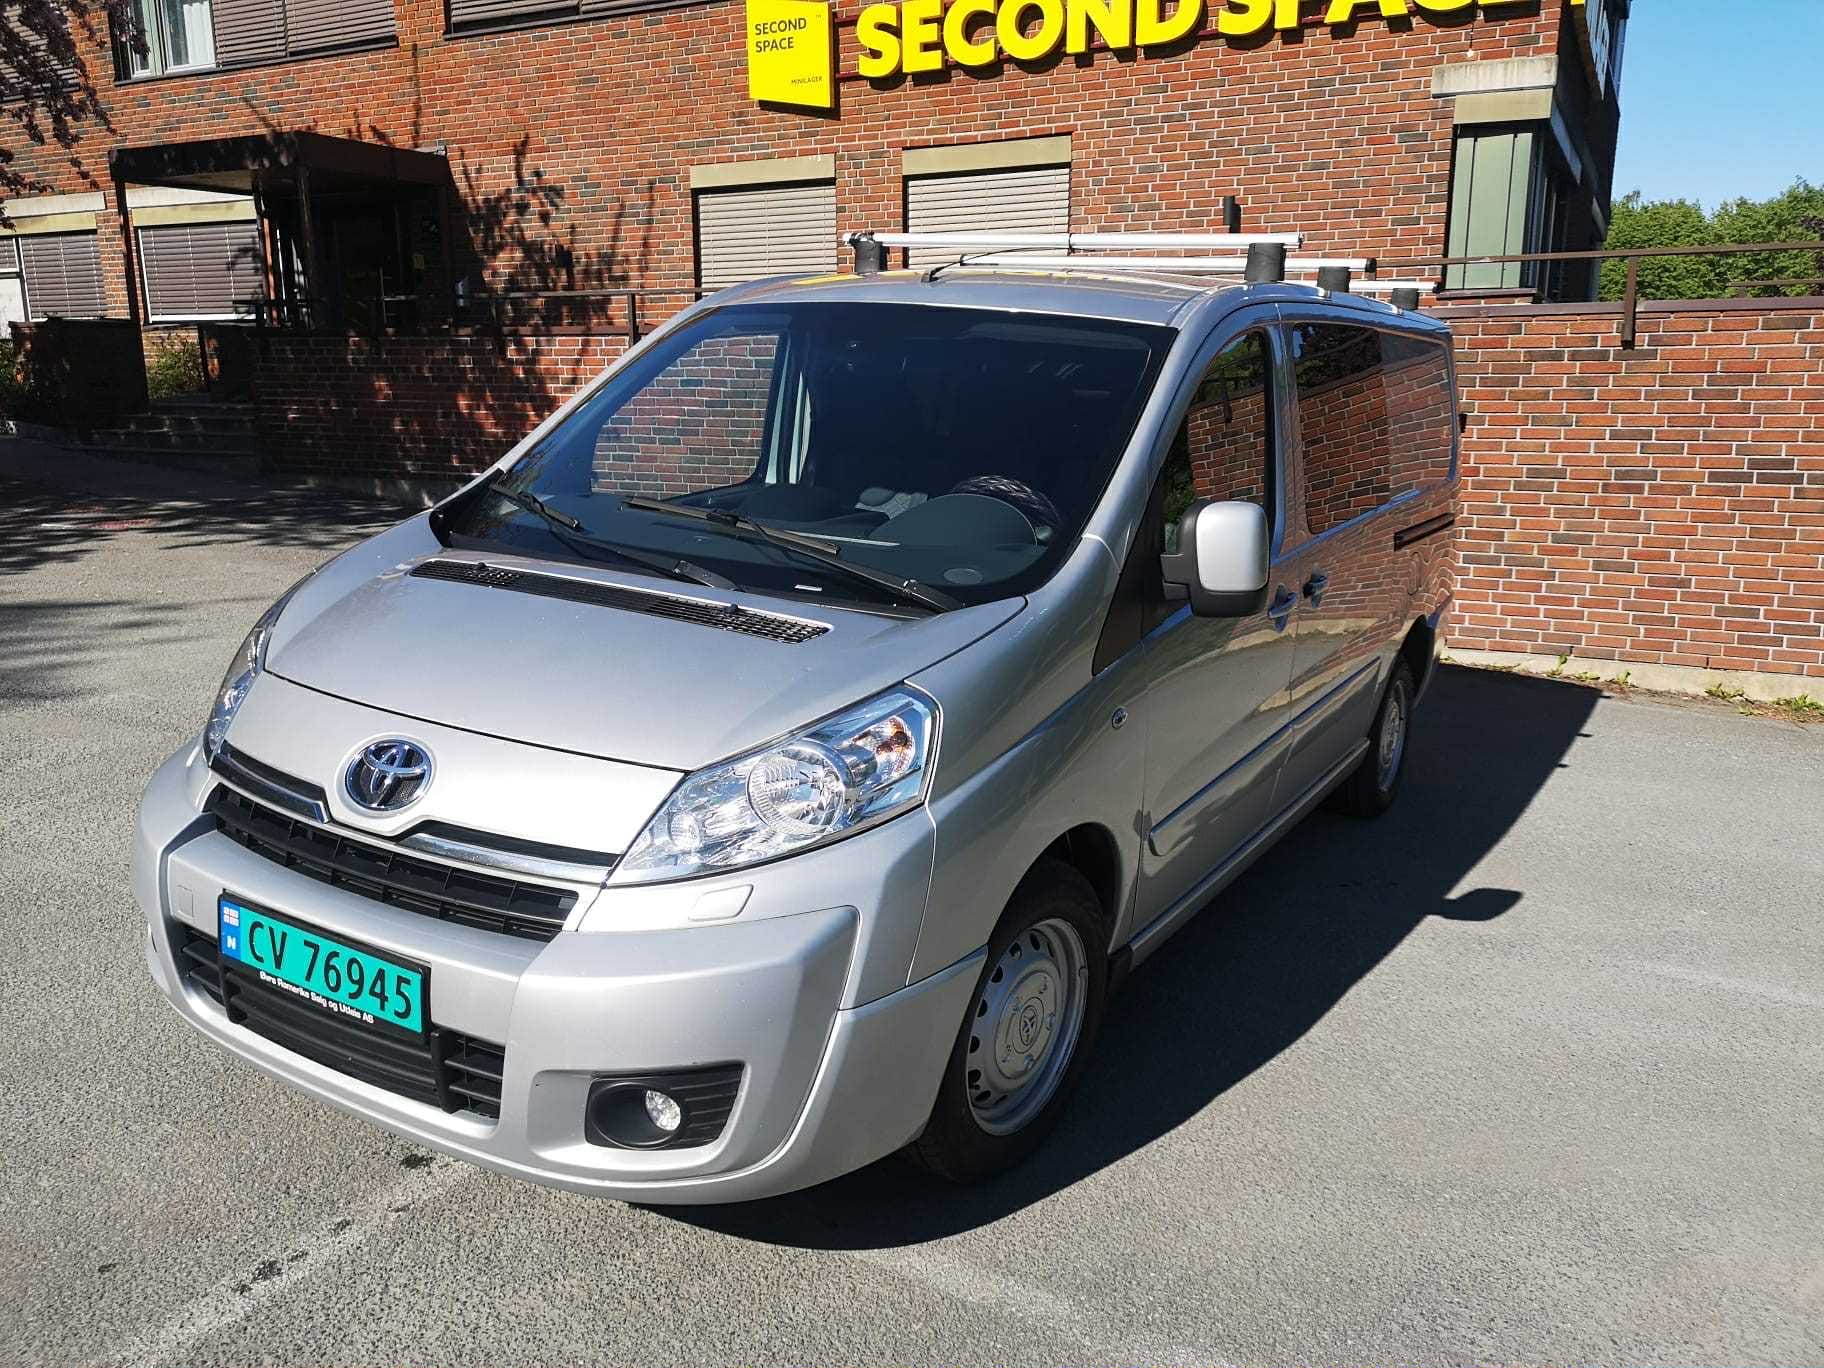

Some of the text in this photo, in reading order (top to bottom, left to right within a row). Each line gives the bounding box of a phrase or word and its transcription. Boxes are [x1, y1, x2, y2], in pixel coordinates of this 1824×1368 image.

[755, 18, 807, 35] SECOND
[755, 37, 794, 53] SPACE
[857, 0, 1201, 77] SECOND
[227, 935, 237, 949] N
[249, 921, 411, 1019] CV 76945
[328, 1000, 339, 1012] og
